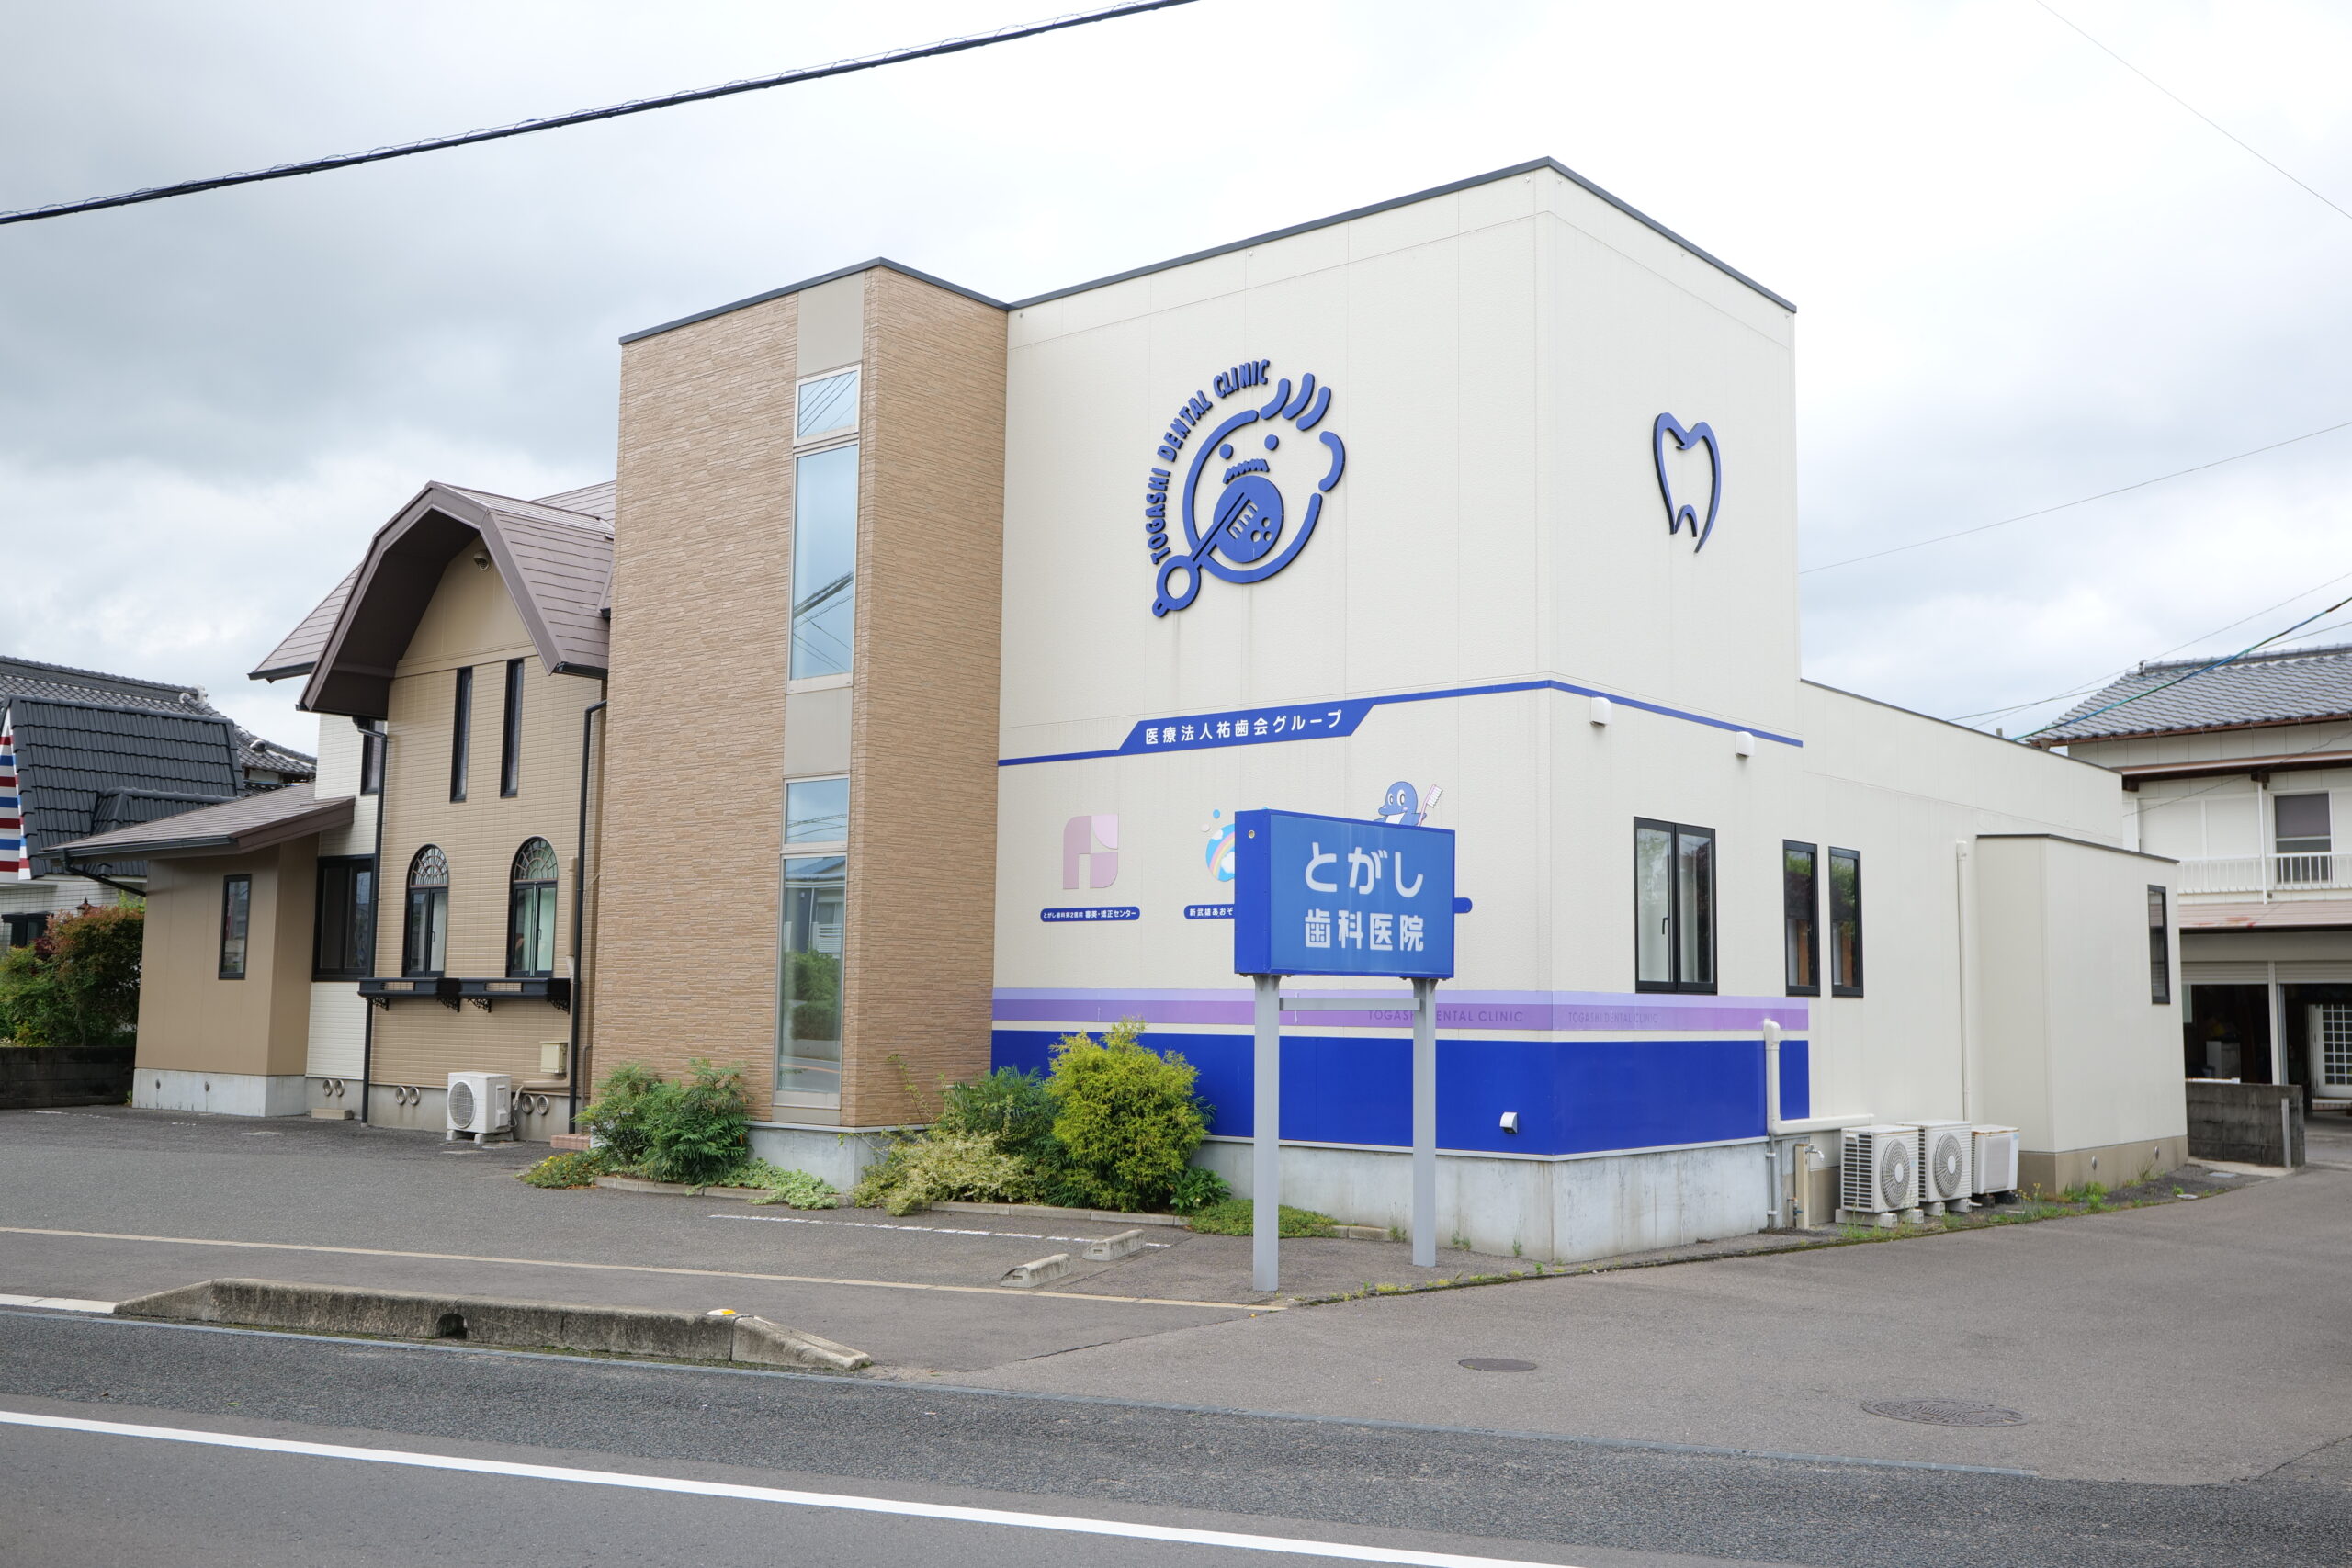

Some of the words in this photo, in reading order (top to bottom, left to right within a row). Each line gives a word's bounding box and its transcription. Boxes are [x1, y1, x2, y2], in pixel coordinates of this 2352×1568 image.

[1213, 359, 1271, 399] CLINIC
[1157, 390, 1214, 463] DENTAL
[1146, 468, 1171, 565] TOGASHI
[1145, 708, 1342, 745] 医療法人祐歯会グループ
[1305, 841, 1424, 898] とがし
[1305, 908, 1424, 952] 歯科医院
[1435, 1010, 1473, 1021] ENTAL
[1478, 1010, 1524, 1022] CLINIC
